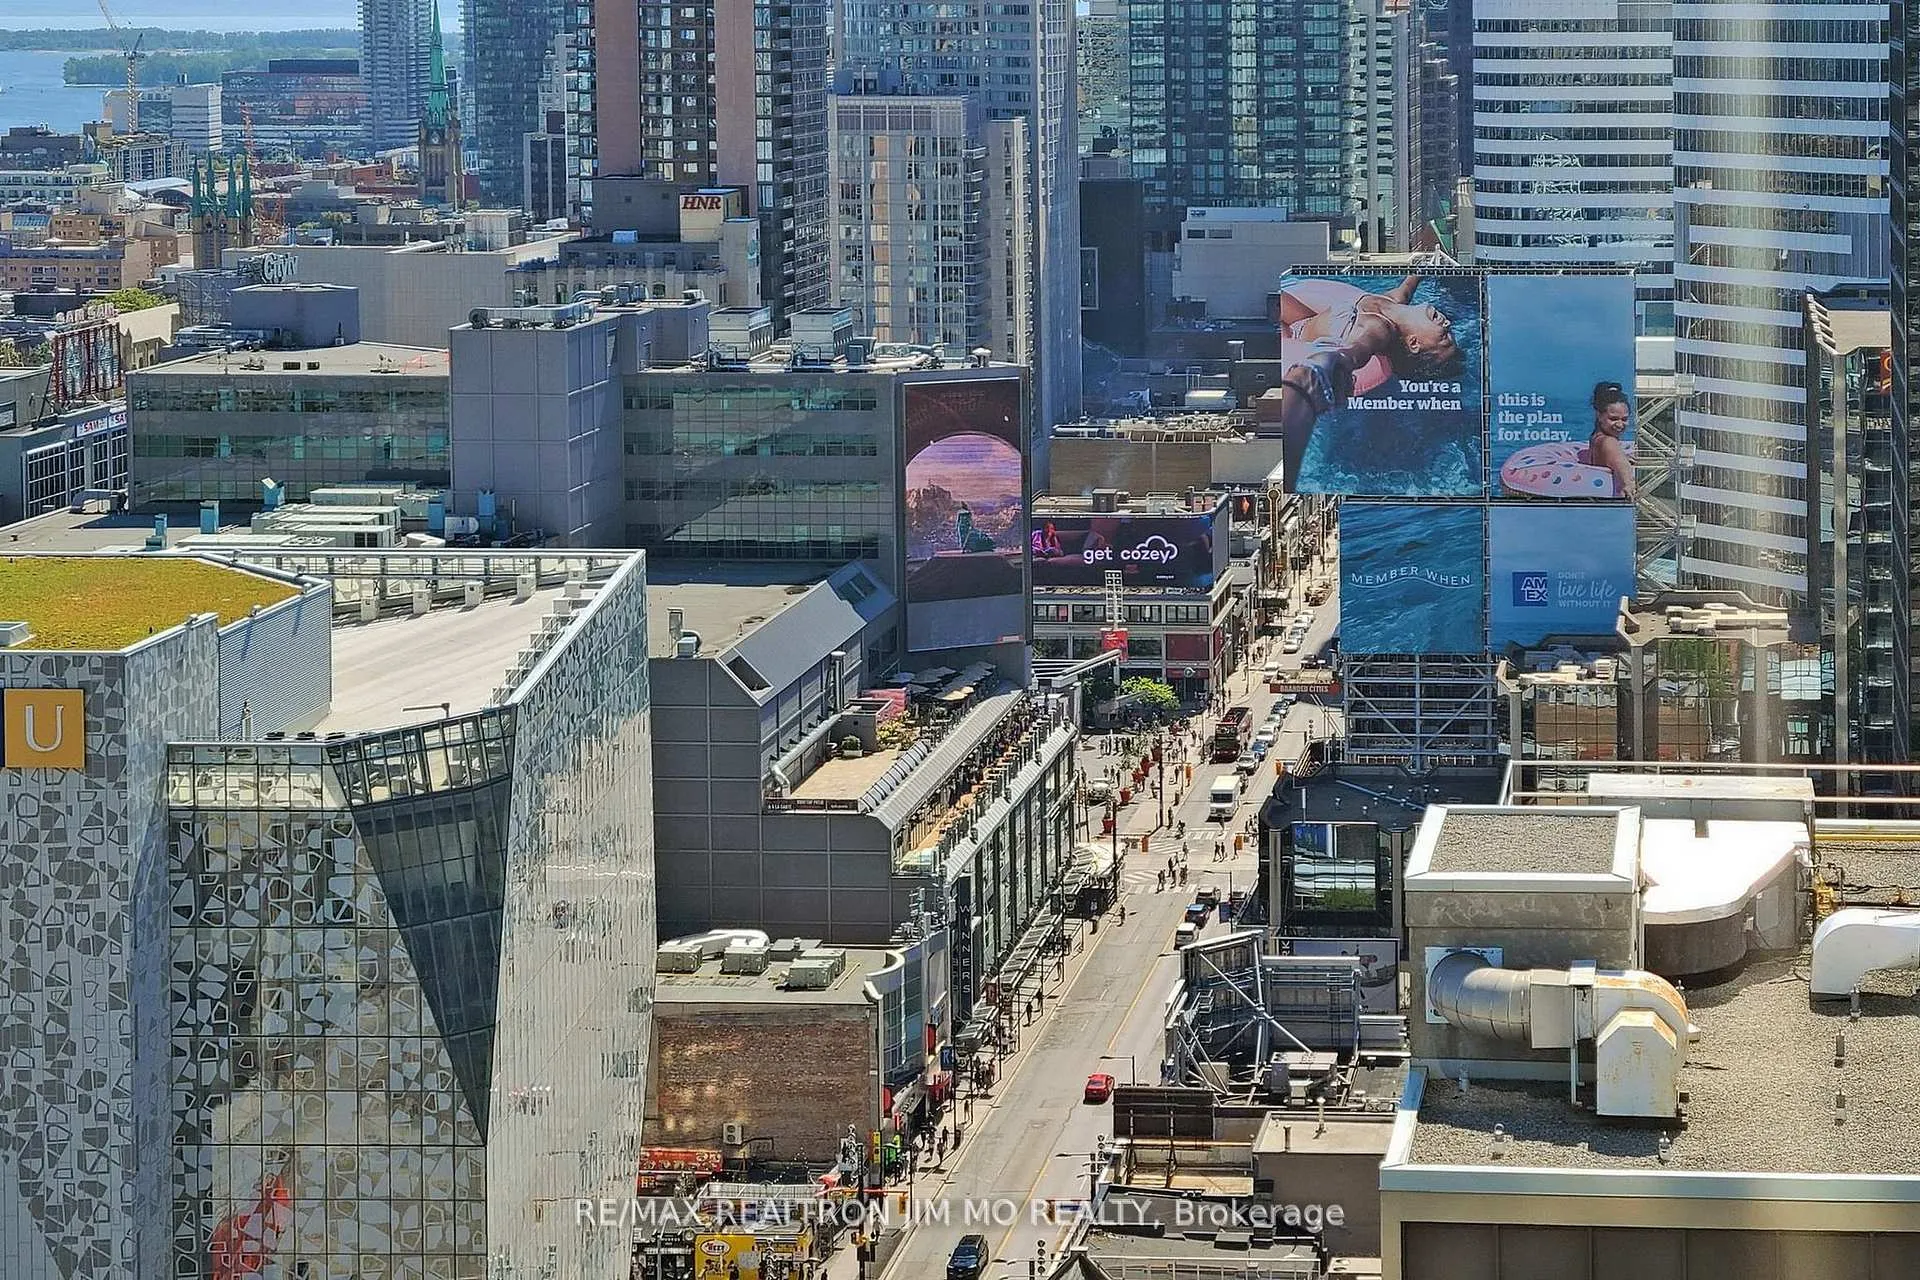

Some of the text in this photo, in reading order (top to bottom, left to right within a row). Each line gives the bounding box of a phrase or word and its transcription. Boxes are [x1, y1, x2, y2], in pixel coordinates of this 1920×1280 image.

[681, 195, 722, 210] HNR
[1399, 379, 1461, 393] You're a
[1347, 396, 1462, 410] Member when
[1498, 392, 1546, 407] this is
[1498, 410, 1563, 426] the plan
[1498, 427, 1572, 442] for today.
[1083, 546, 1171, 564] get cozey
[1351, 566, 1471, 586] MEMBER WHEN
[1558, 571, 1585, 579] DON'T
[1521, 576, 1548, 591] AM
[1558, 579, 1617, 600] live life
[1525, 590, 1549, 602] EX
[1559, 600, 1611, 608] WITHOUT IT
[25, 704, 64, 752] U
[960, 904, 971, 993] WINNERS
